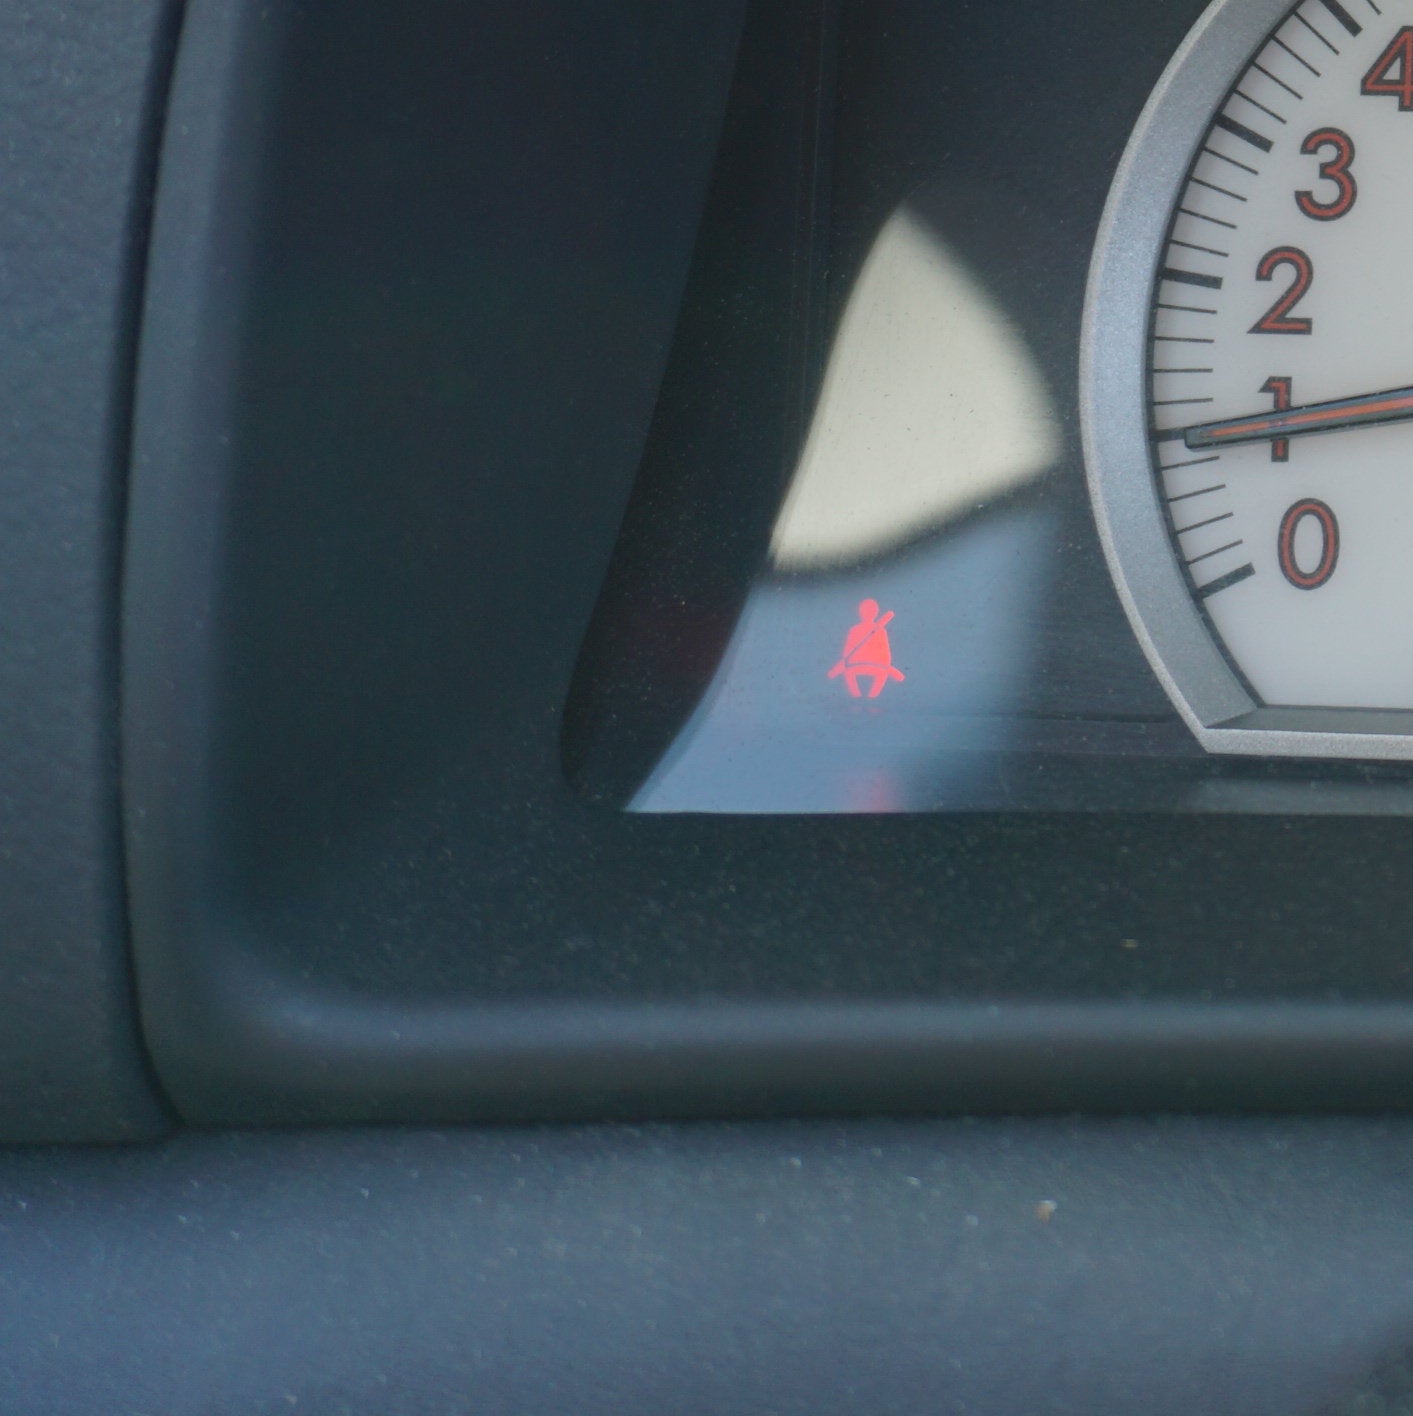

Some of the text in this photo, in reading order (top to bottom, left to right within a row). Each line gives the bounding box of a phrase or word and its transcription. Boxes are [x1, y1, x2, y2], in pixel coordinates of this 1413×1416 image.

[1295, 127, 1357, 221] 3
[1247, 246, 1313, 335] 2
[1259, 376, 1290, 462] 1
[1278, 498, 1339, 590] 0
